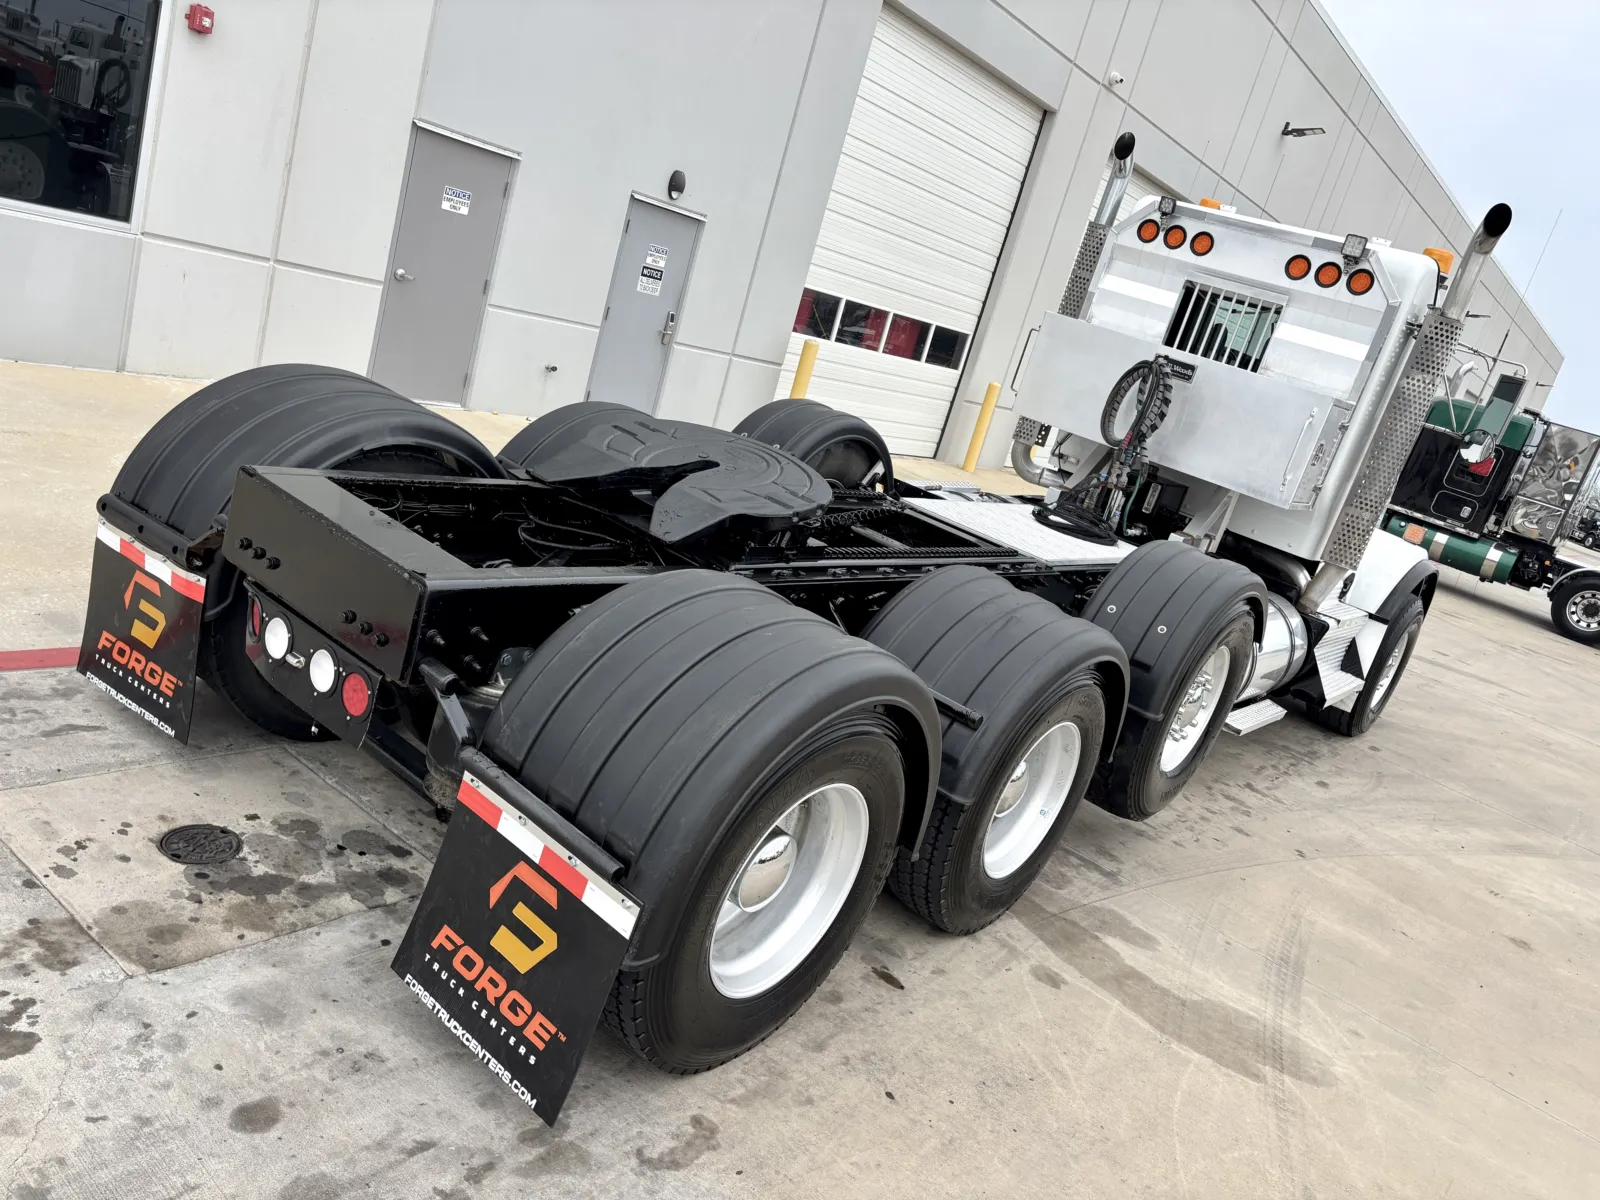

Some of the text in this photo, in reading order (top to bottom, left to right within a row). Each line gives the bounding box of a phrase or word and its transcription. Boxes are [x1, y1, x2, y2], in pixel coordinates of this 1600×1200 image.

[443, 196, 469, 207] EMPLOYEES
[445, 187, 470, 201] NOTICE
[649, 245, 668, 255] NOTICE
[642, 268, 662, 279] NOTICE
[95, 653, 170, 709] TRUCK CENTERS
[86, 671, 176, 738] FORGETRUCKCENTERS.COM
[424, 953, 536, 1065] TRUCK CENTERS
[403, 973, 537, 1109] FORGETRUCKCENTERS.COM
